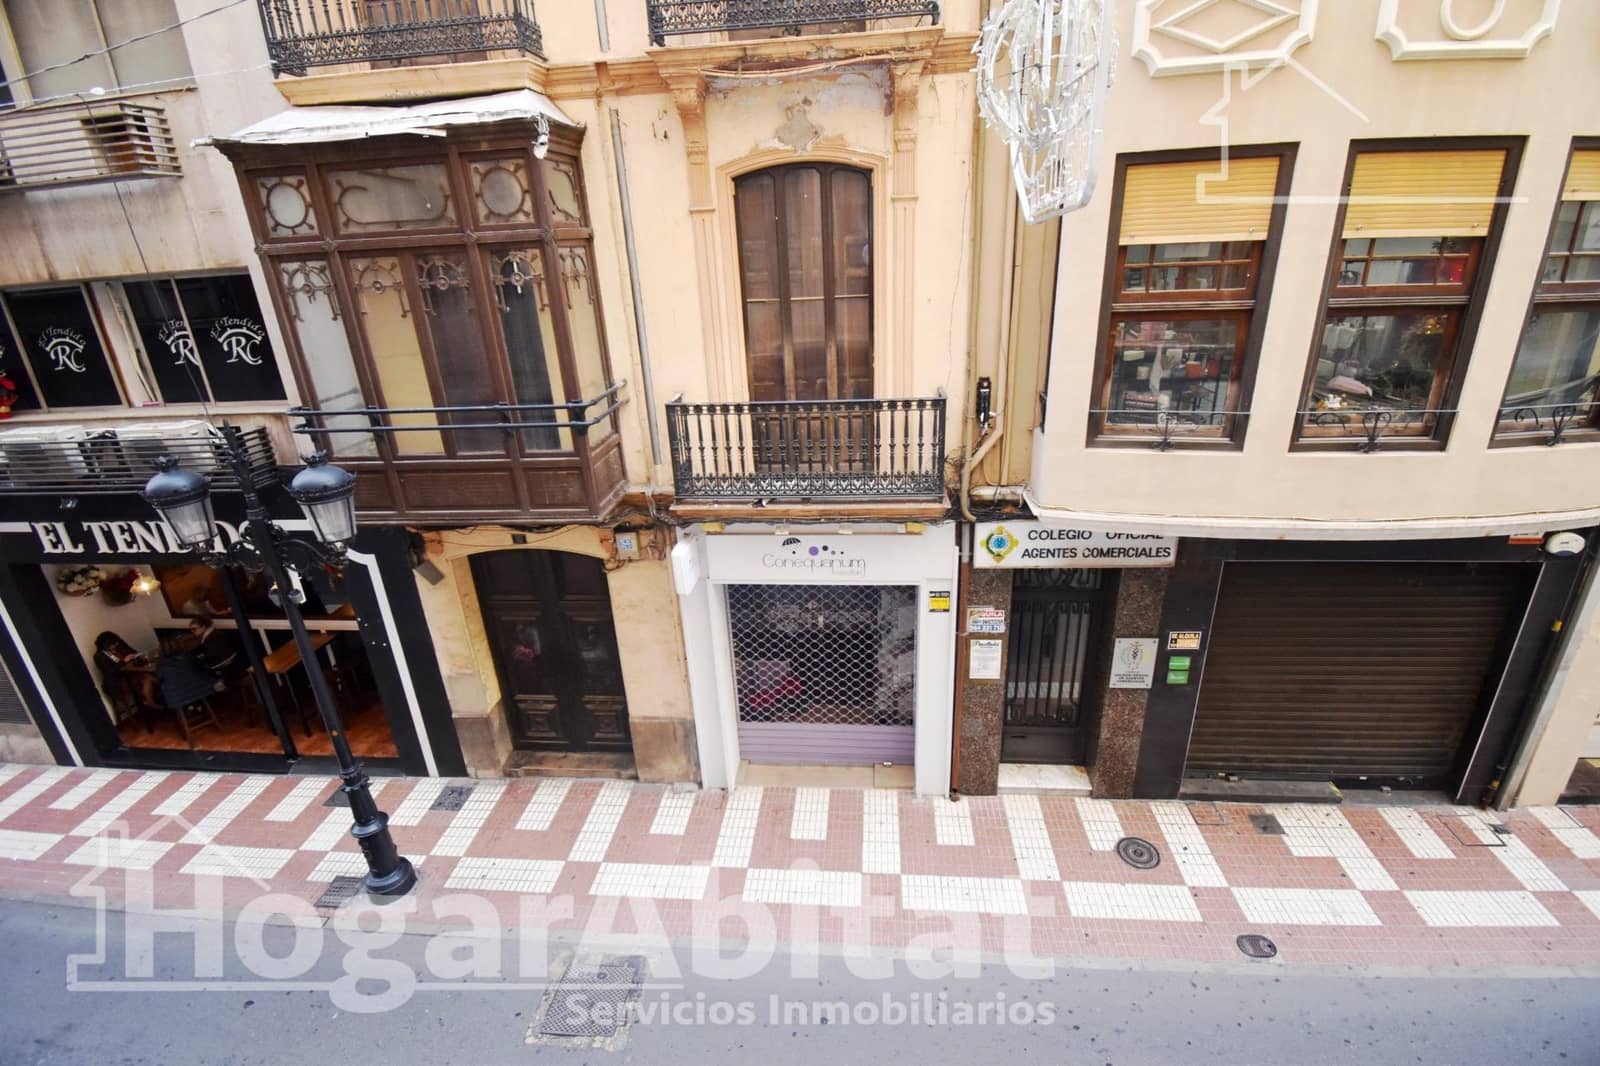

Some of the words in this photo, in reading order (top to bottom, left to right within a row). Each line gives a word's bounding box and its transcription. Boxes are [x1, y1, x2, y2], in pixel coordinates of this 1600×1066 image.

[220, 316, 265, 337] Tendido
[31, 522, 84, 554] EL
[1027, 529, 1093, 541] COLEGIO
[1021, 547, 1078, 559] AGENTES
[1082, 546, 1171, 559] COMERCIALES
